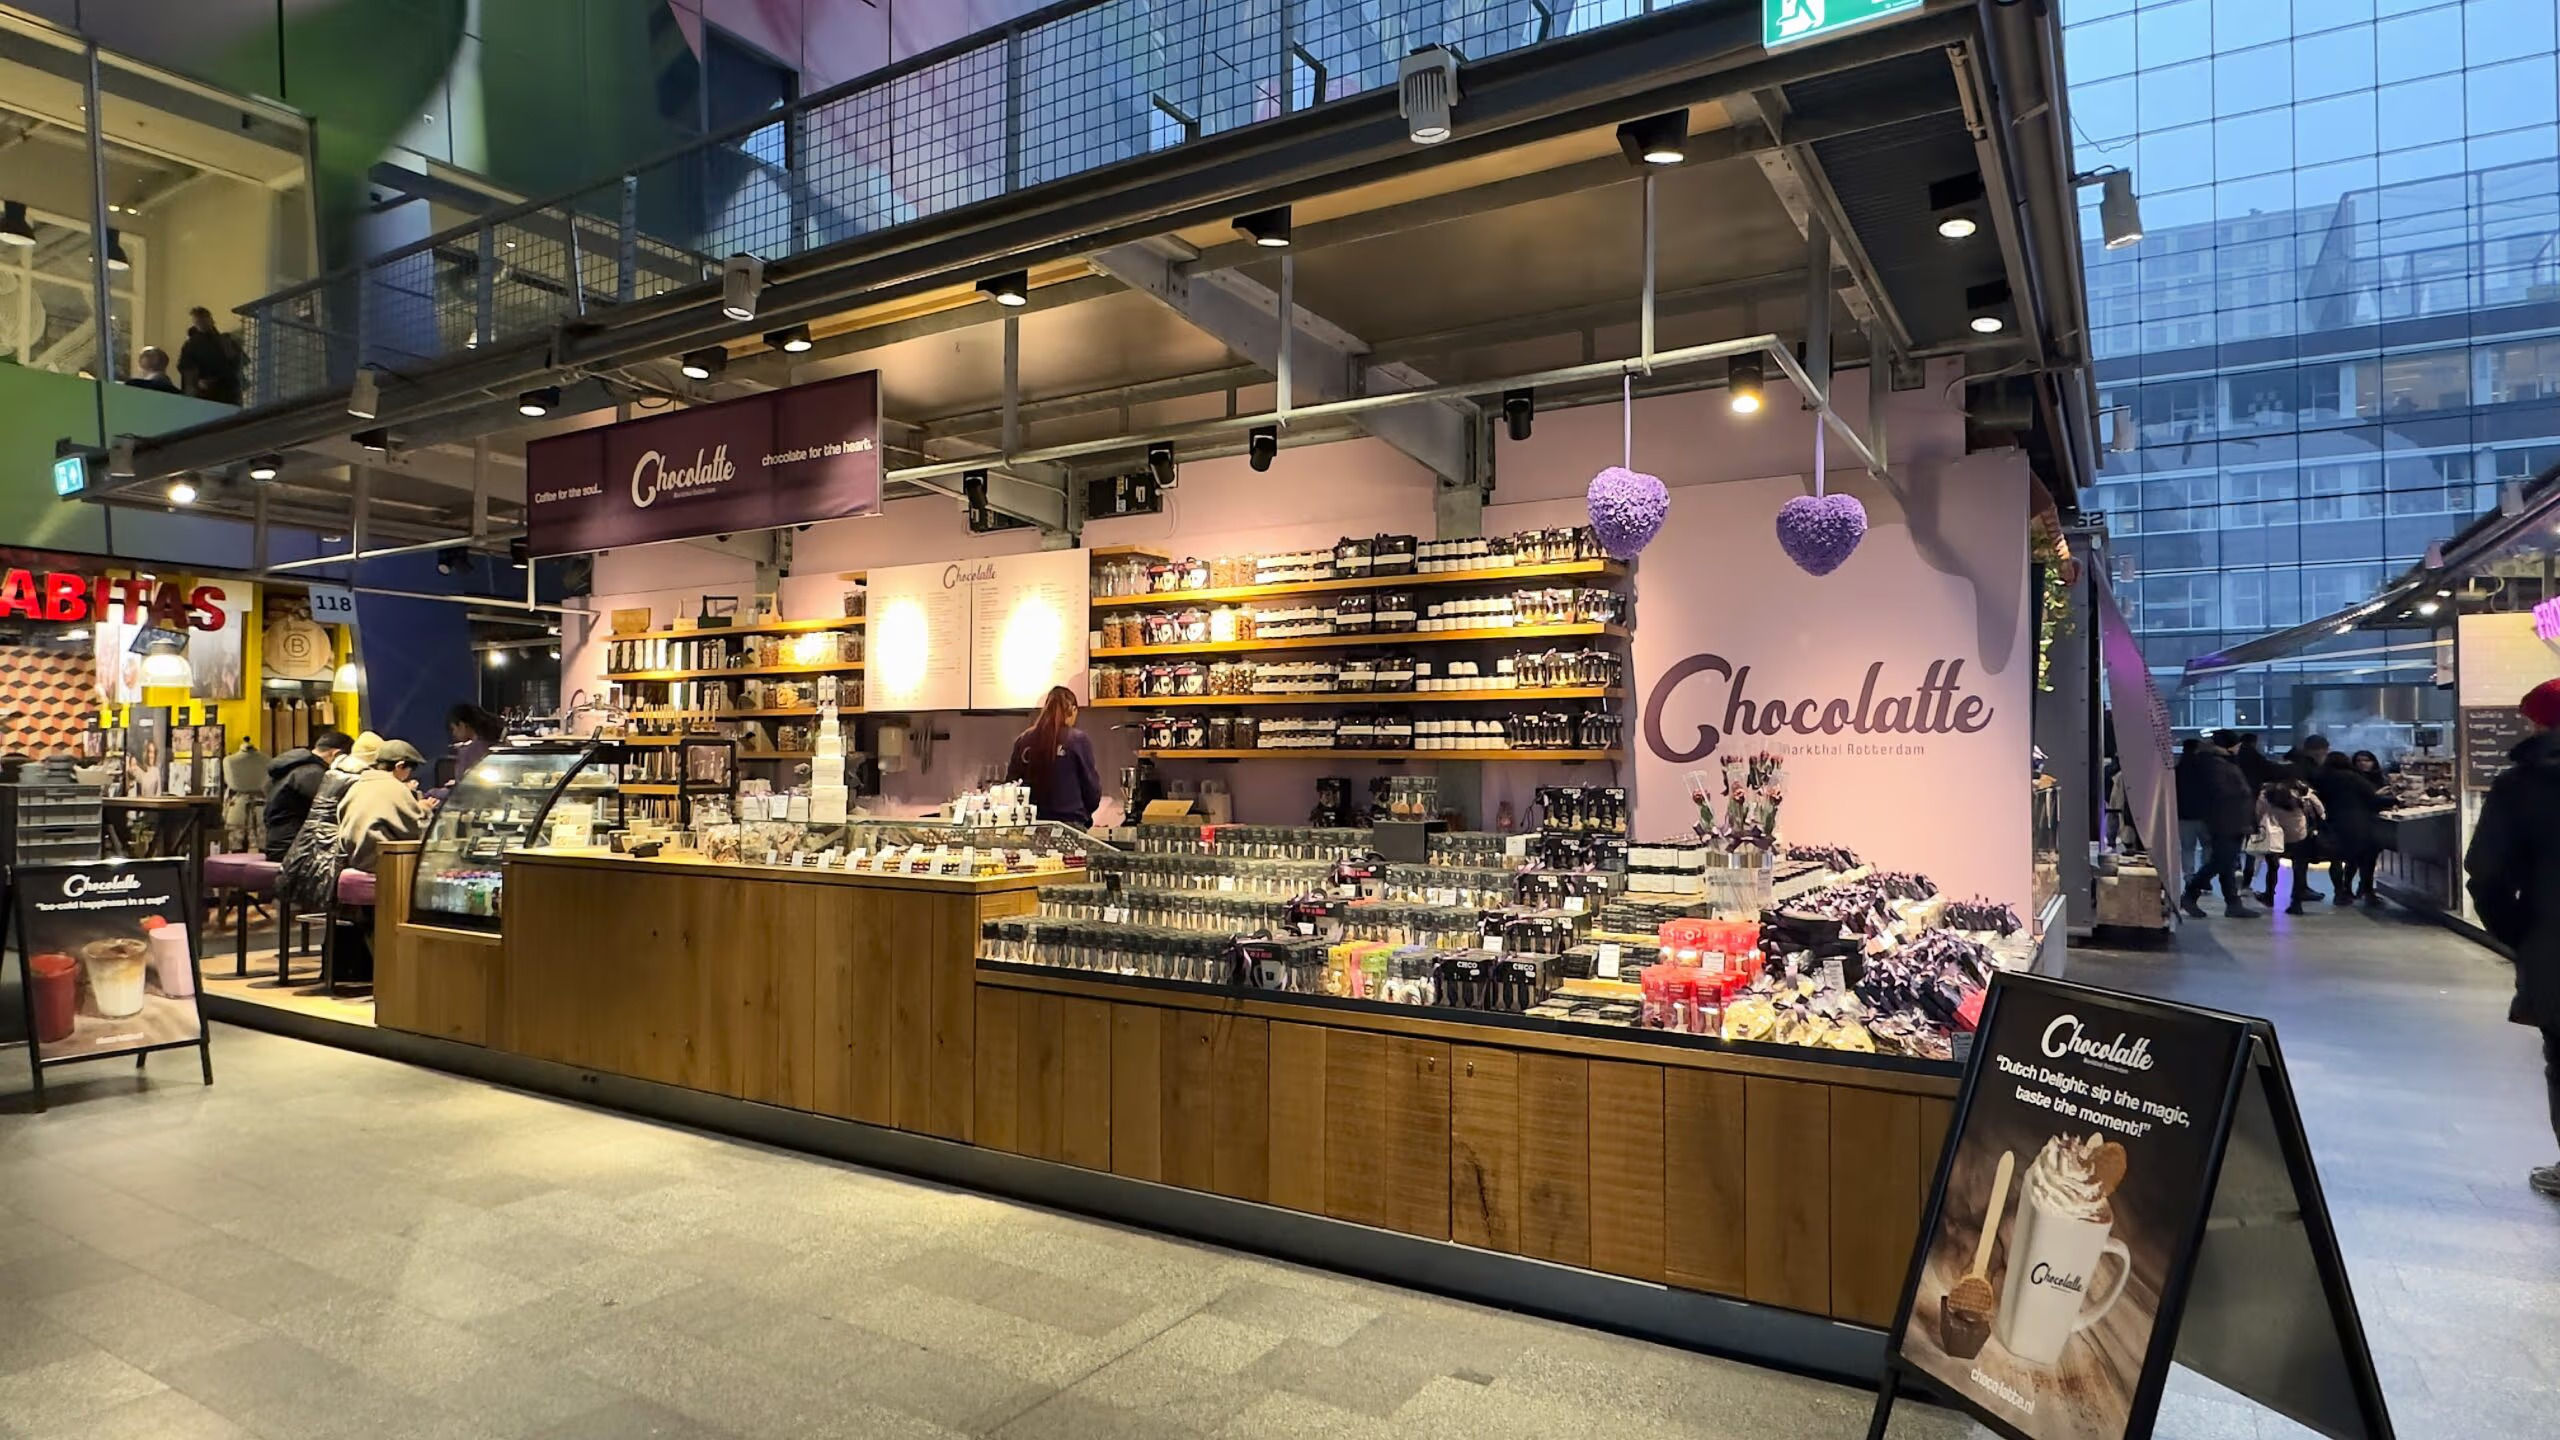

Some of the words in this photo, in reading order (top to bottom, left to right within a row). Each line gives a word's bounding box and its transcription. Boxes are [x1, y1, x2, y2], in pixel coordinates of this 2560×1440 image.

[761, 448, 807, 467] chocolate
[809, 446, 823, 459] for
[824, 443, 842, 455] the
[843, 437, 873, 453] heart.
[558, 489, 568, 500] for
[569, 487, 581, 498] the
[631, 443, 736, 508] Chocolatte
[315, 594, 352, 612] 118
[1644, 653, 1994, 763] Chocolatte
[1847, 743, 1925, 755] Rotterdam
[63, 873, 141, 897] Chocolatte
[2041, 1014, 2154, 1071] Chocolatte
[1996, 1054, 2037, 1081] “Dutch
[2091, 1084, 2111, 1105] sip
[2113, 1090, 2140, 1110] the
[2142, 1100, 2190, 1128] magic,
[2016, 1085, 2052, 1108] taste
[2053, 1096, 2077, 1116] the
[2079, 1106, 2152, 1138] moment!”
